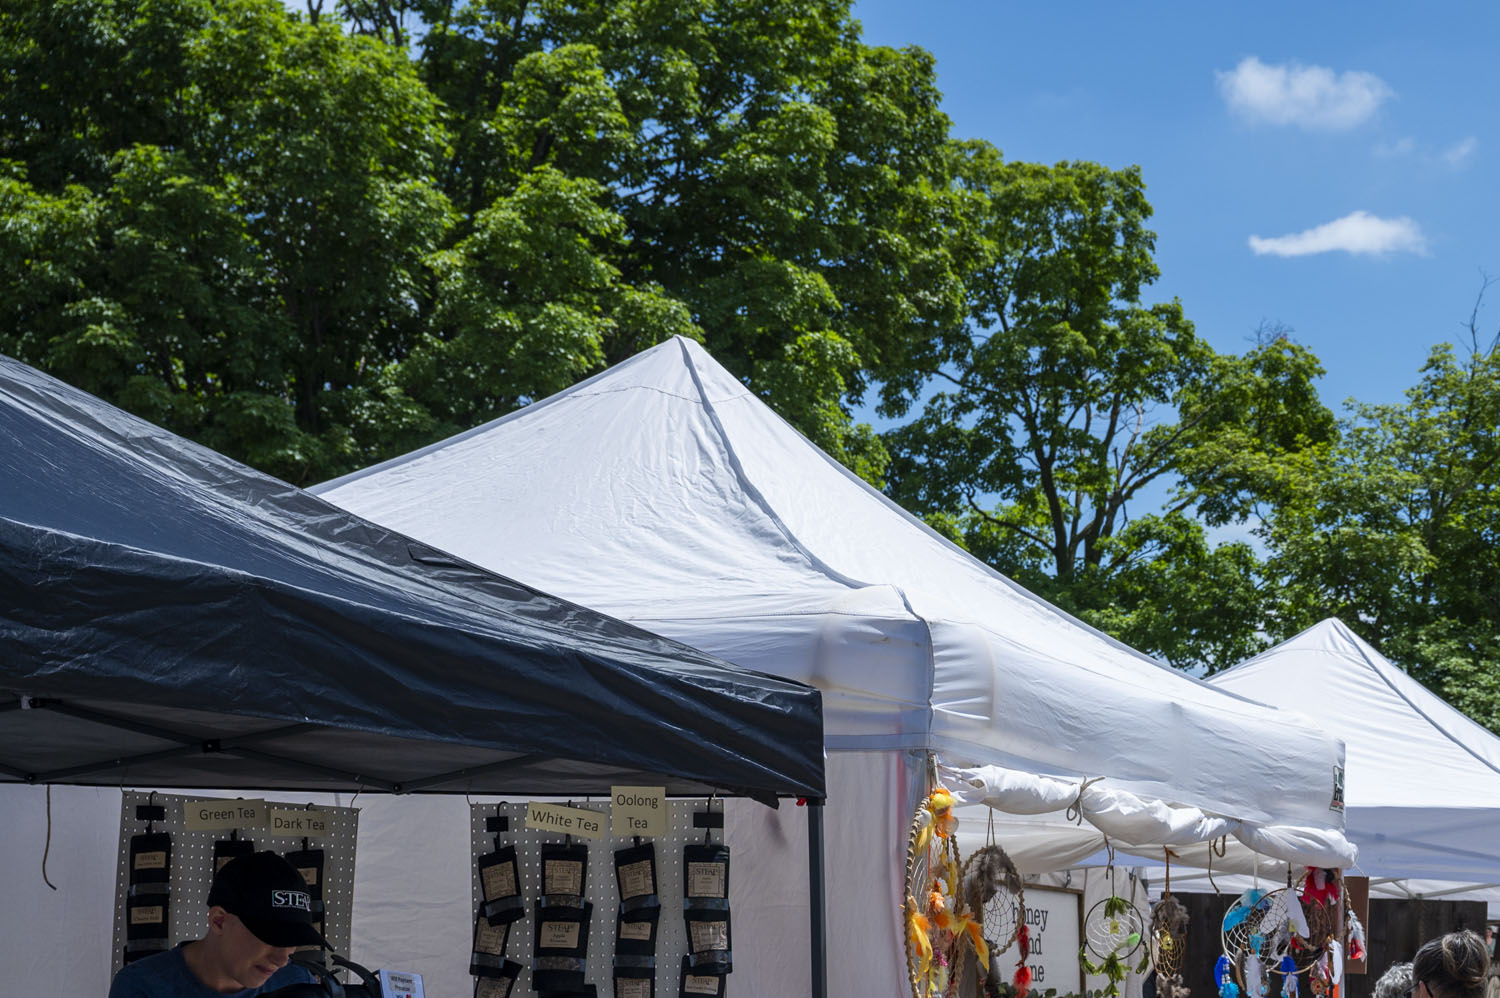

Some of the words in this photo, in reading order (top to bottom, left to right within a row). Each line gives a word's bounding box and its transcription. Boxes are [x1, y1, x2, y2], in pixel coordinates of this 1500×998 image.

[616, 794, 658, 809] Oolong
[199, 808, 235, 821] Green
[237, 807, 255, 819] Tea
[531, 809, 573, 828] White
[576, 817, 600, 832] Tea
[274, 817, 302, 829] Dark
[306, 819, 325, 830] Tea
[626, 816, 648, 829] Tea
[1028, 933, 1042, 955] nd
[1030, 964, 1044, 982] ne
